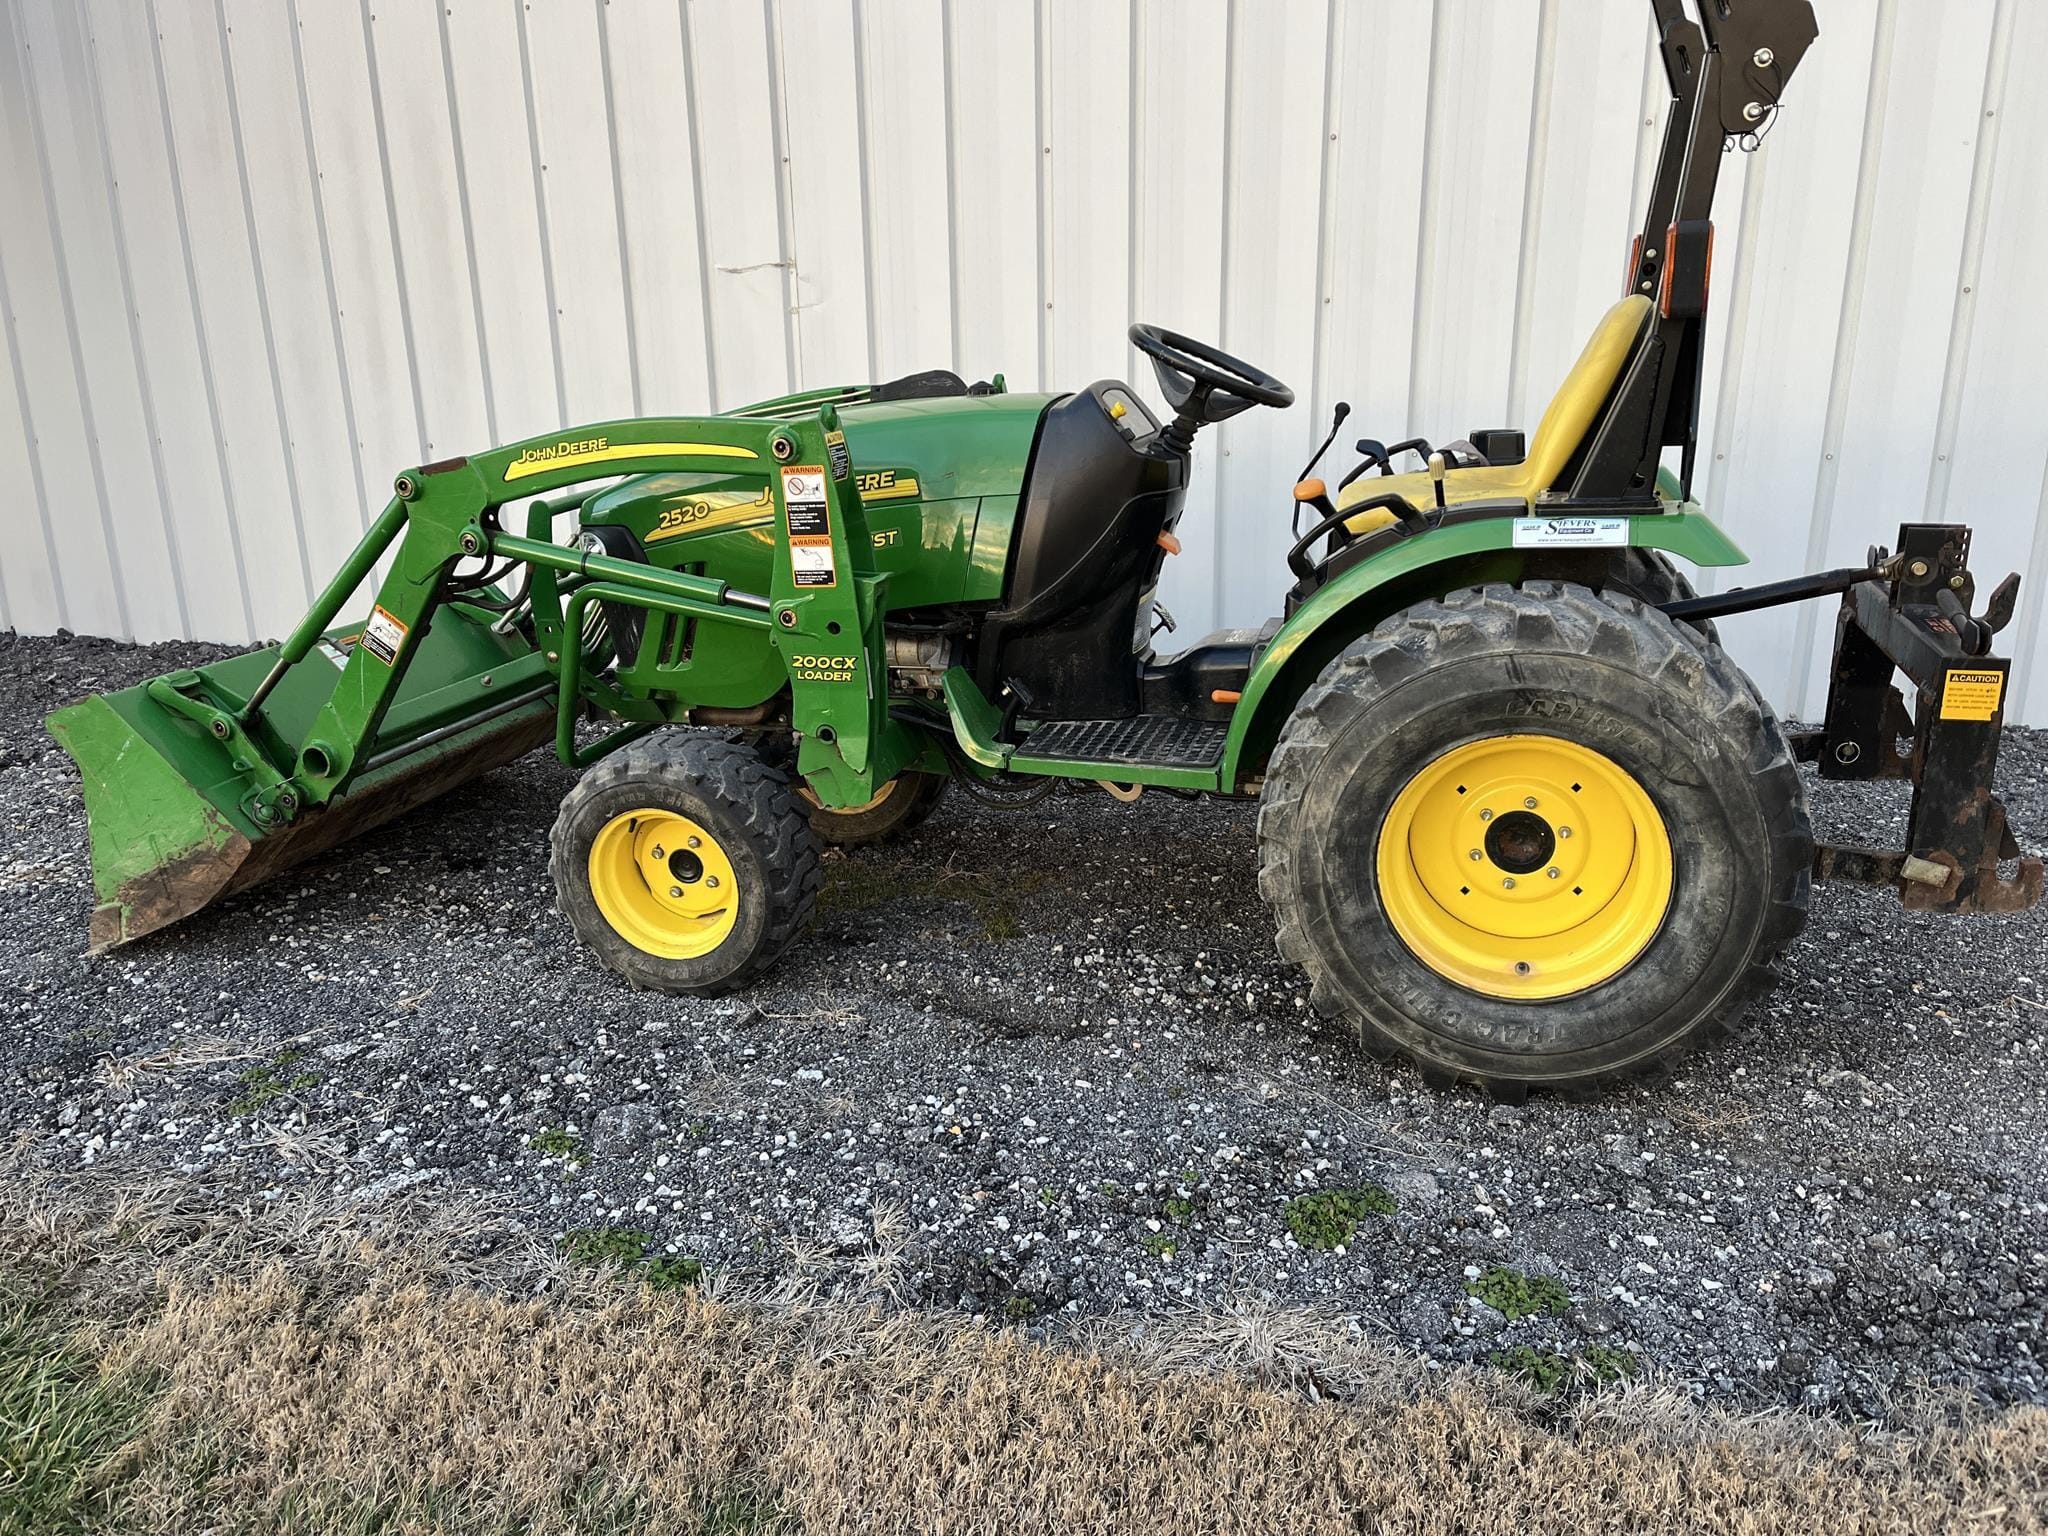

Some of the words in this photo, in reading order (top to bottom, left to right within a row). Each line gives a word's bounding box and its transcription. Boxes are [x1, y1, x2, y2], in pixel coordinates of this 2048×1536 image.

[517, 446, 556, 464] JOHN
[558, 437, 608, 457] DEERE
[855, 470, 895, 491] ERE
[659, 501, 710, 530] 2520
[1545, 520, 1597, 535] SIEVERS
[871, 530, 898, 548] ST
[792, 655, 858, 670] 200CX
[797, 670, 852, 682] LOADER
[1959, 674, 1998, 683] CAUTION
